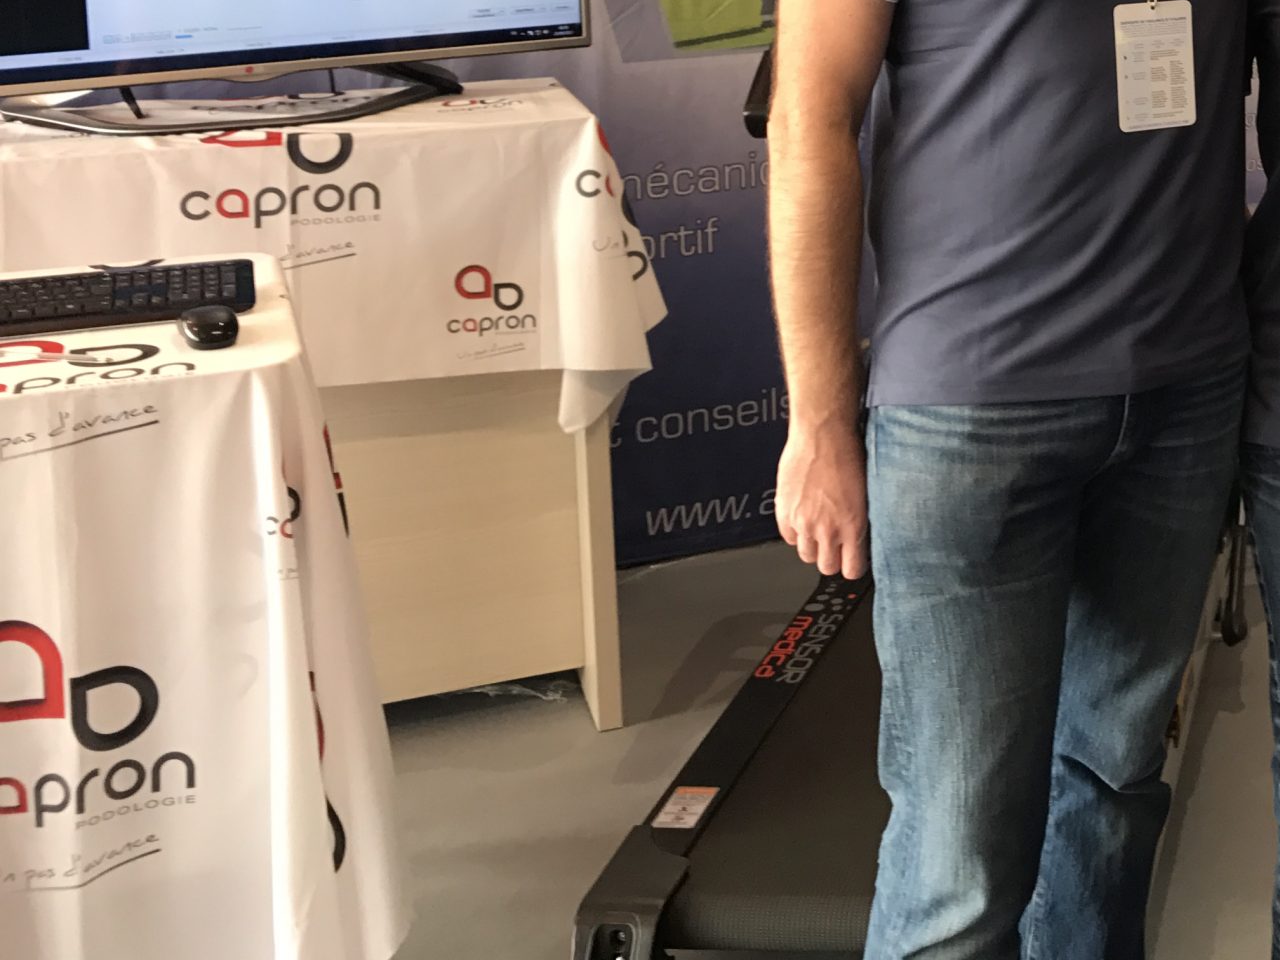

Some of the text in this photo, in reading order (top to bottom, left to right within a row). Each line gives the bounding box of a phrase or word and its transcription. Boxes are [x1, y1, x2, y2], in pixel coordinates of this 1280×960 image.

[180, 181, 381, 229] capron
[290, 214, 381, 226] PODOLOGIE
[446, 314, 537, 337] capron
[0, 751, 196, 828] apron
[75, 794, 197, 829] PODOLOGIE
